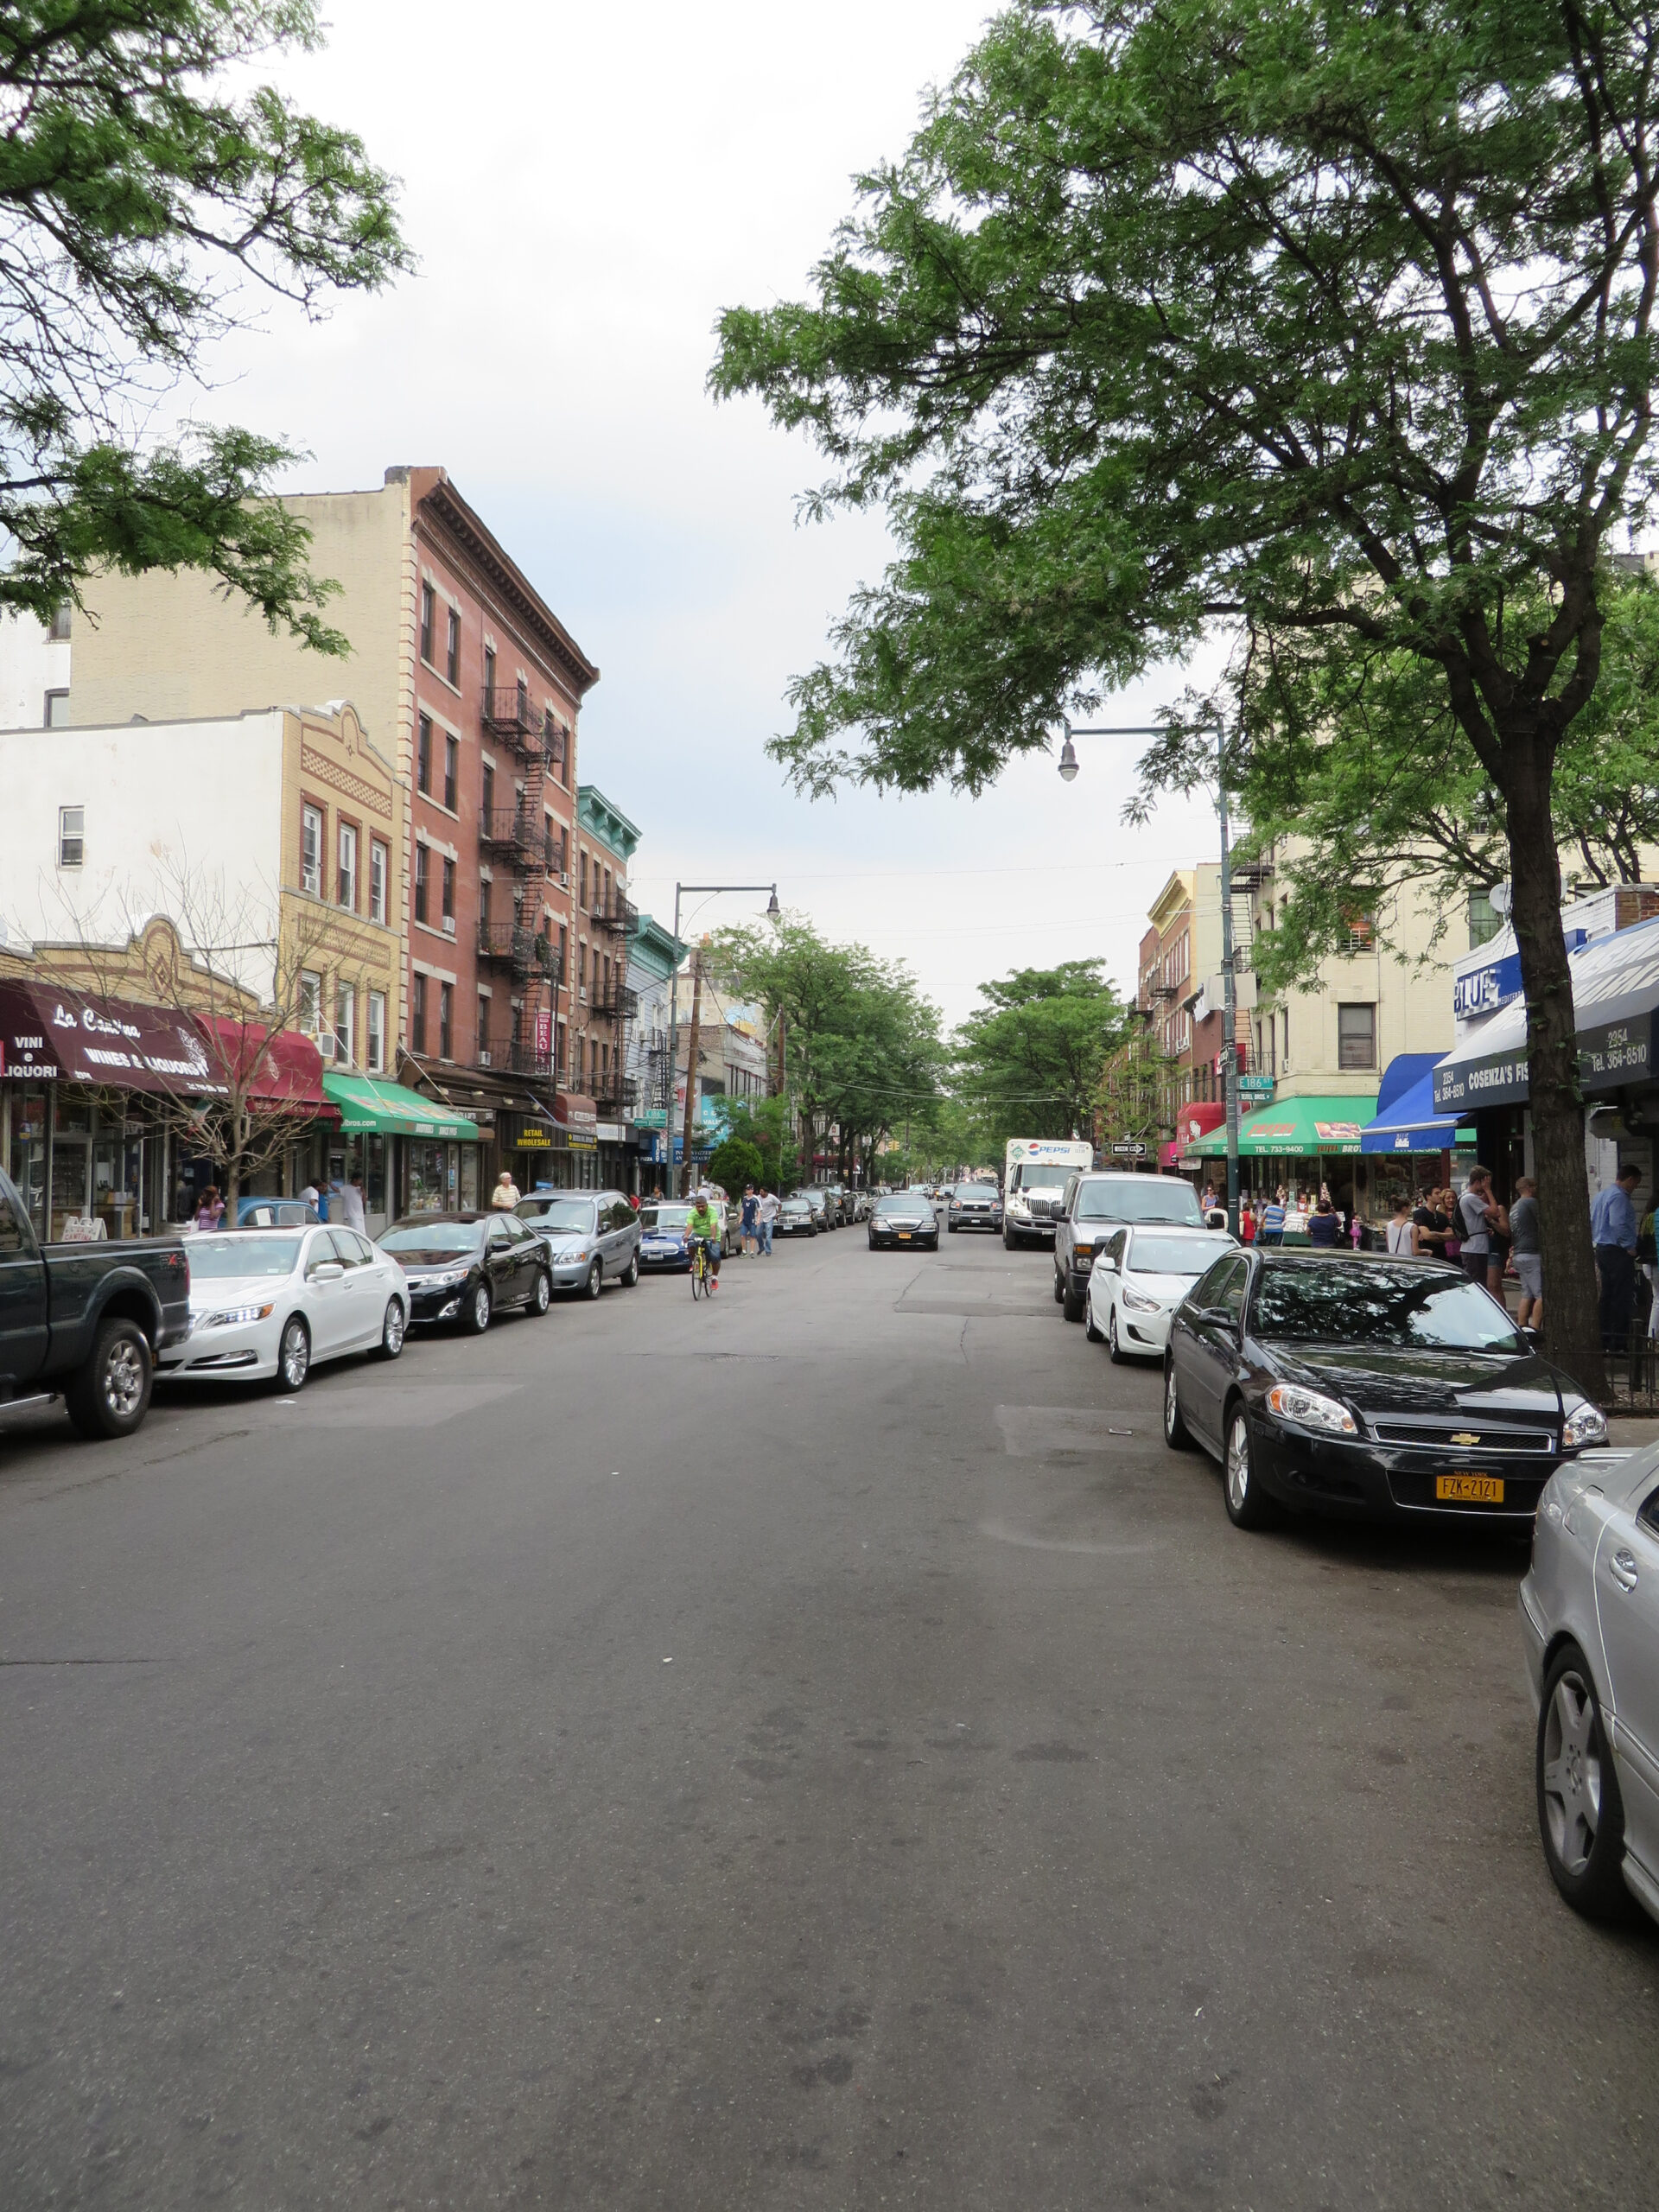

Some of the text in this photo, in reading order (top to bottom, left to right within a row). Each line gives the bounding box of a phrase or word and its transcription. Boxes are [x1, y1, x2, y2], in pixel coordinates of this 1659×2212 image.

[1453, 969, 1497, 1014] BLUE
[54, 1004, 78, 1028] La
[15, 1037, 43, 1048] VINI
[1608, 1027, 1628, 1048] 2354
[24, 1052, 34, 1063] e
[84, 1047, 200, 1076] WINES & LIQUORS
[1592, 1054, 1605, 1072] Tel.
[1607, 1044, 1647, 1070] 364-8510
[1240, 1078, 1244, 1087] E
[1246, 1077, 1262, 1088] 186
[1443, 1071, 1454, 1085] 2354
[1469, 1065, 1512, 1090] COSENZA'S
[1442, 1083, 1465, 1101] 364-8510
[518, 1138, 551, 1147] WHOLESALE
[1039, 1146, 1070, 1154] PEPSI
